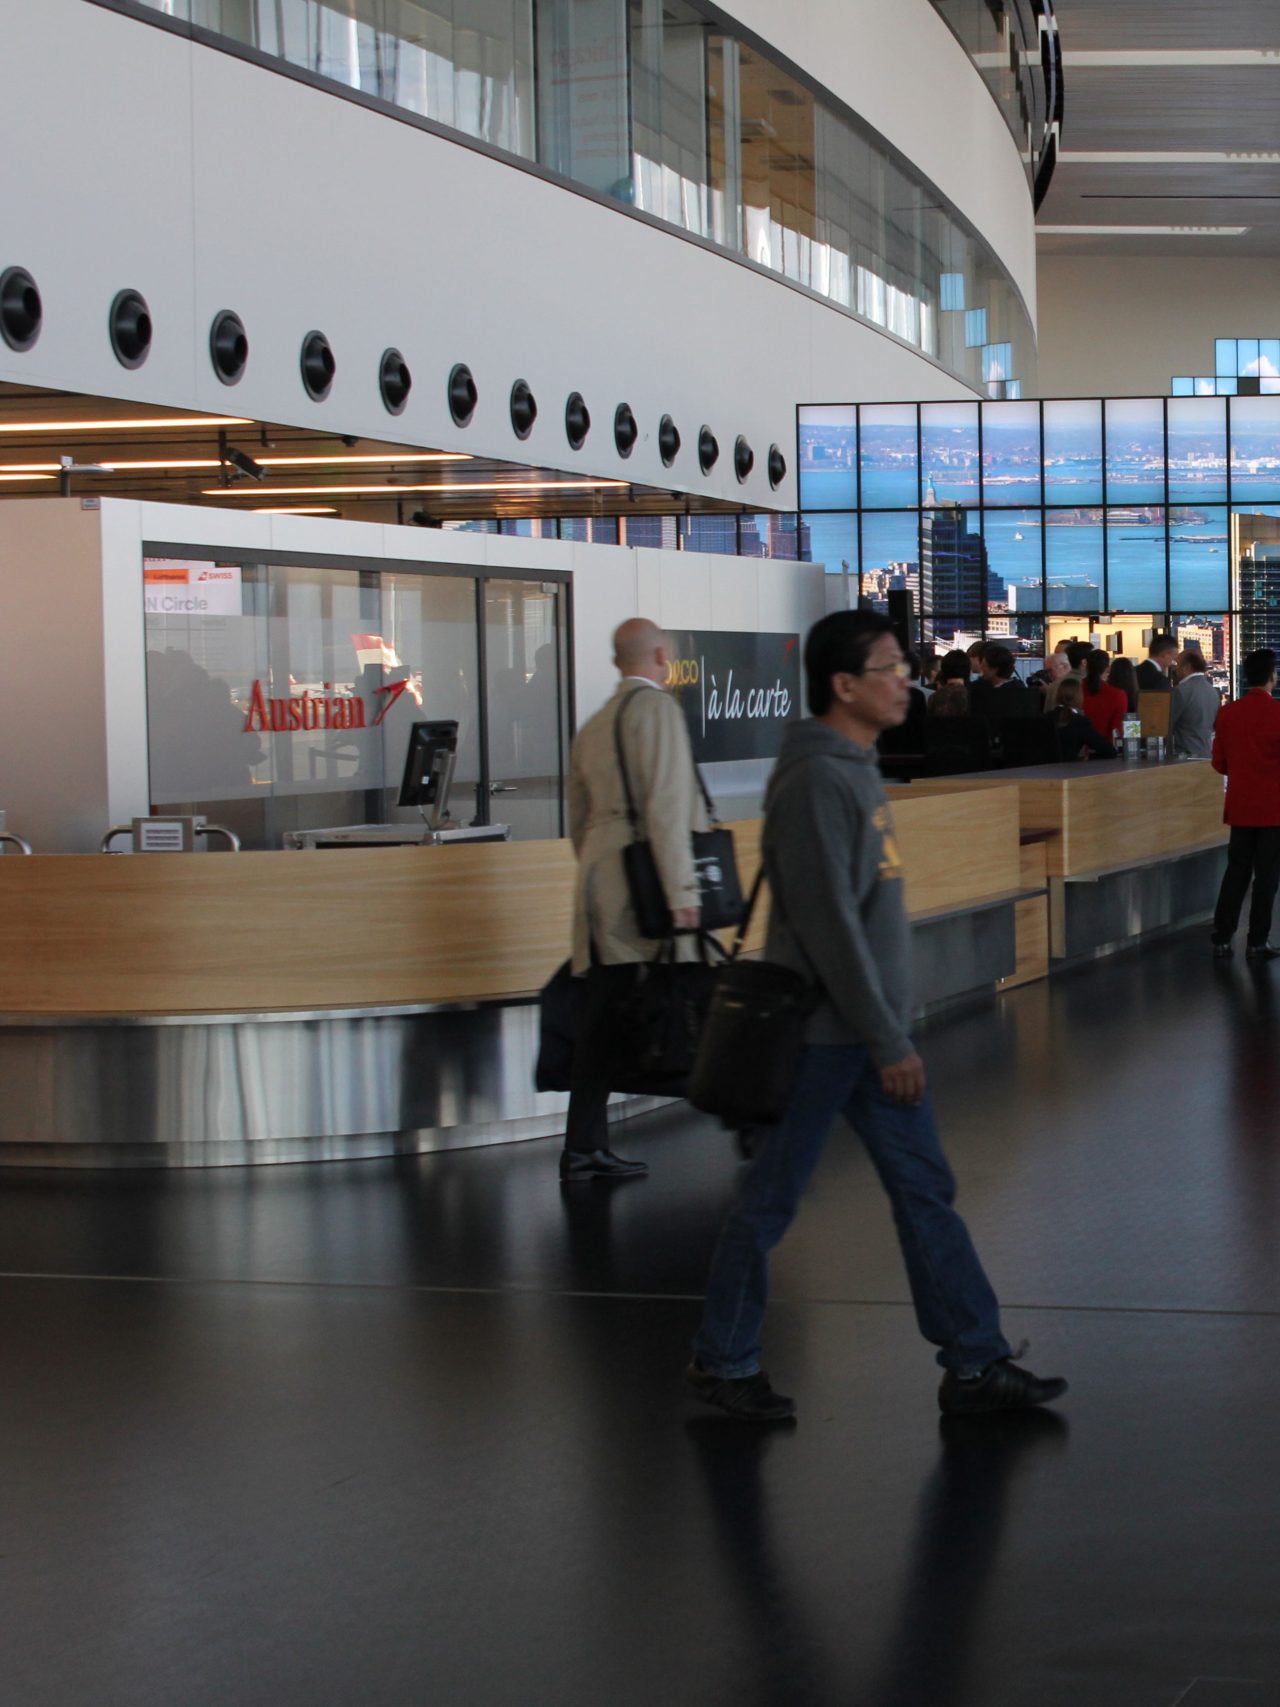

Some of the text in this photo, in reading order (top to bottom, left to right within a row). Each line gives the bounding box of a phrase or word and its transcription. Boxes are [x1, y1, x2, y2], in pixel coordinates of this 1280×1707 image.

[161, 596, 209, 612] Circle
[244, 679, 367, 733] Austrian
[708, 674, 723, 720] à
[725, 669, 745, 719] la
[746, 678, 792, 719] carte
